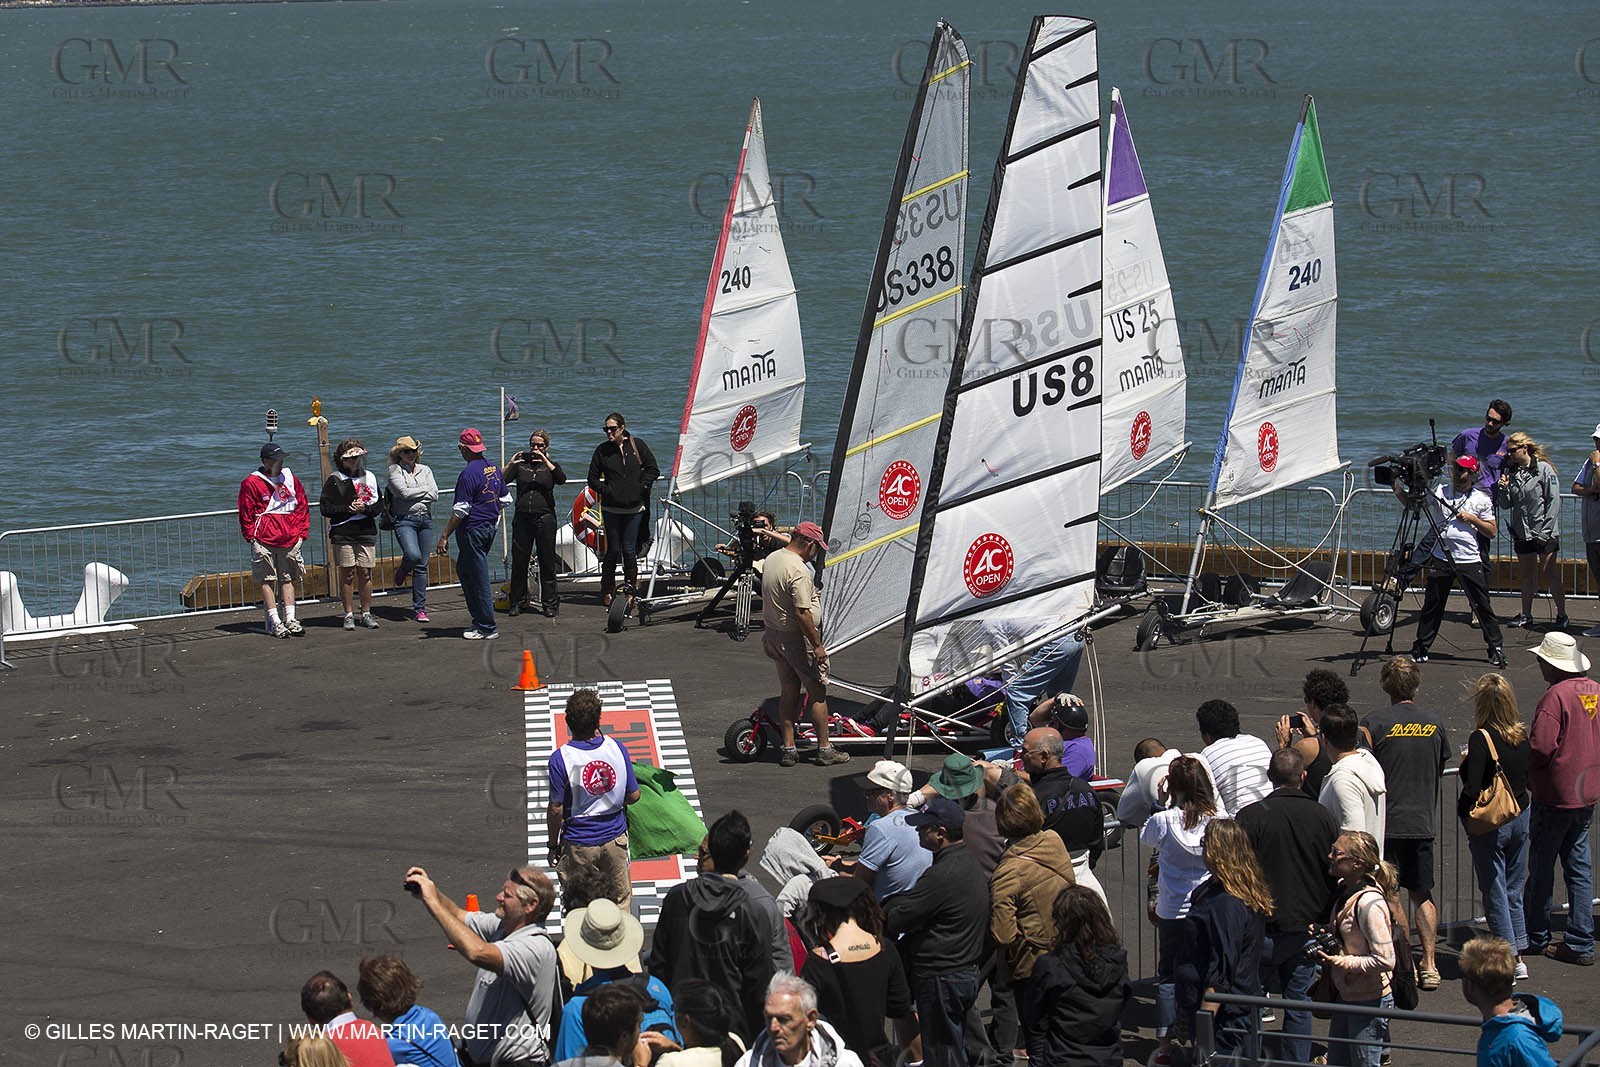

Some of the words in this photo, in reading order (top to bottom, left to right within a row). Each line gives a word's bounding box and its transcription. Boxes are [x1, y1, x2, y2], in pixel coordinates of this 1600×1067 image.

[721, 265, 751, 294] 240
[1288, 258, 1321, 291] 240
[1110, 308, 1135, 343] US
[1138, 298, 1160, 333] 25
[722, 349, 776, 391] MANTA
[1119, 349, 1164, 392] MANTA
[1259, 356, 1307, 400] MANTA
[1012, 355, 1094, 417] US8
[736, 415, 752, 435] AC
[1135, 422, 1147, 443] AC
[1262, 433, 1274, 453] AC
[886, 473, 913, 495] AC
[887, 496, 908, 506] OPEN
[973, 549, 1004, 575] AC
[975, 573, 1001, 586] OPEN
